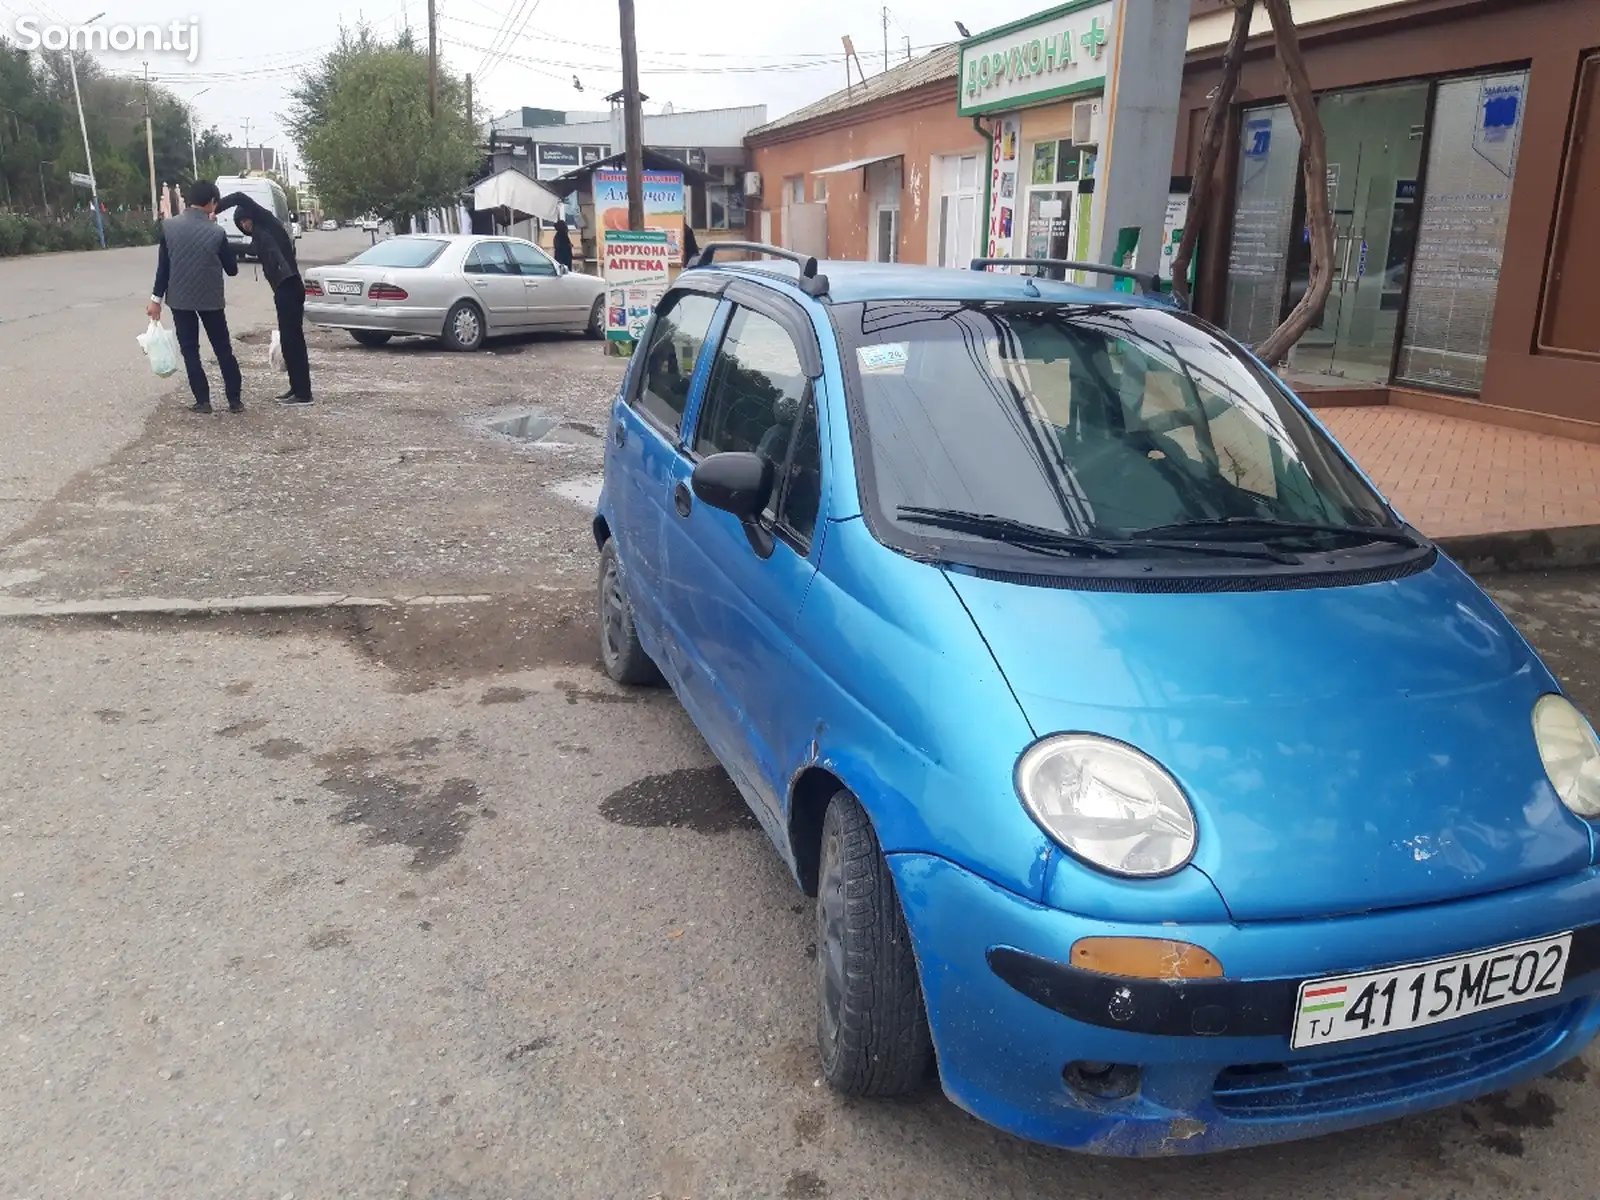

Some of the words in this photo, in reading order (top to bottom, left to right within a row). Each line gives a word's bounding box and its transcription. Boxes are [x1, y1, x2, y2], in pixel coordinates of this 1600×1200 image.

[966, 30, 1075, 94] ДОРУХОНА
[606, 244, 667, 257] ДОРУХОНА
[609, 258, 665, 272] АПТЕКА
[1308, 1017, 1334, 1039] TJ
